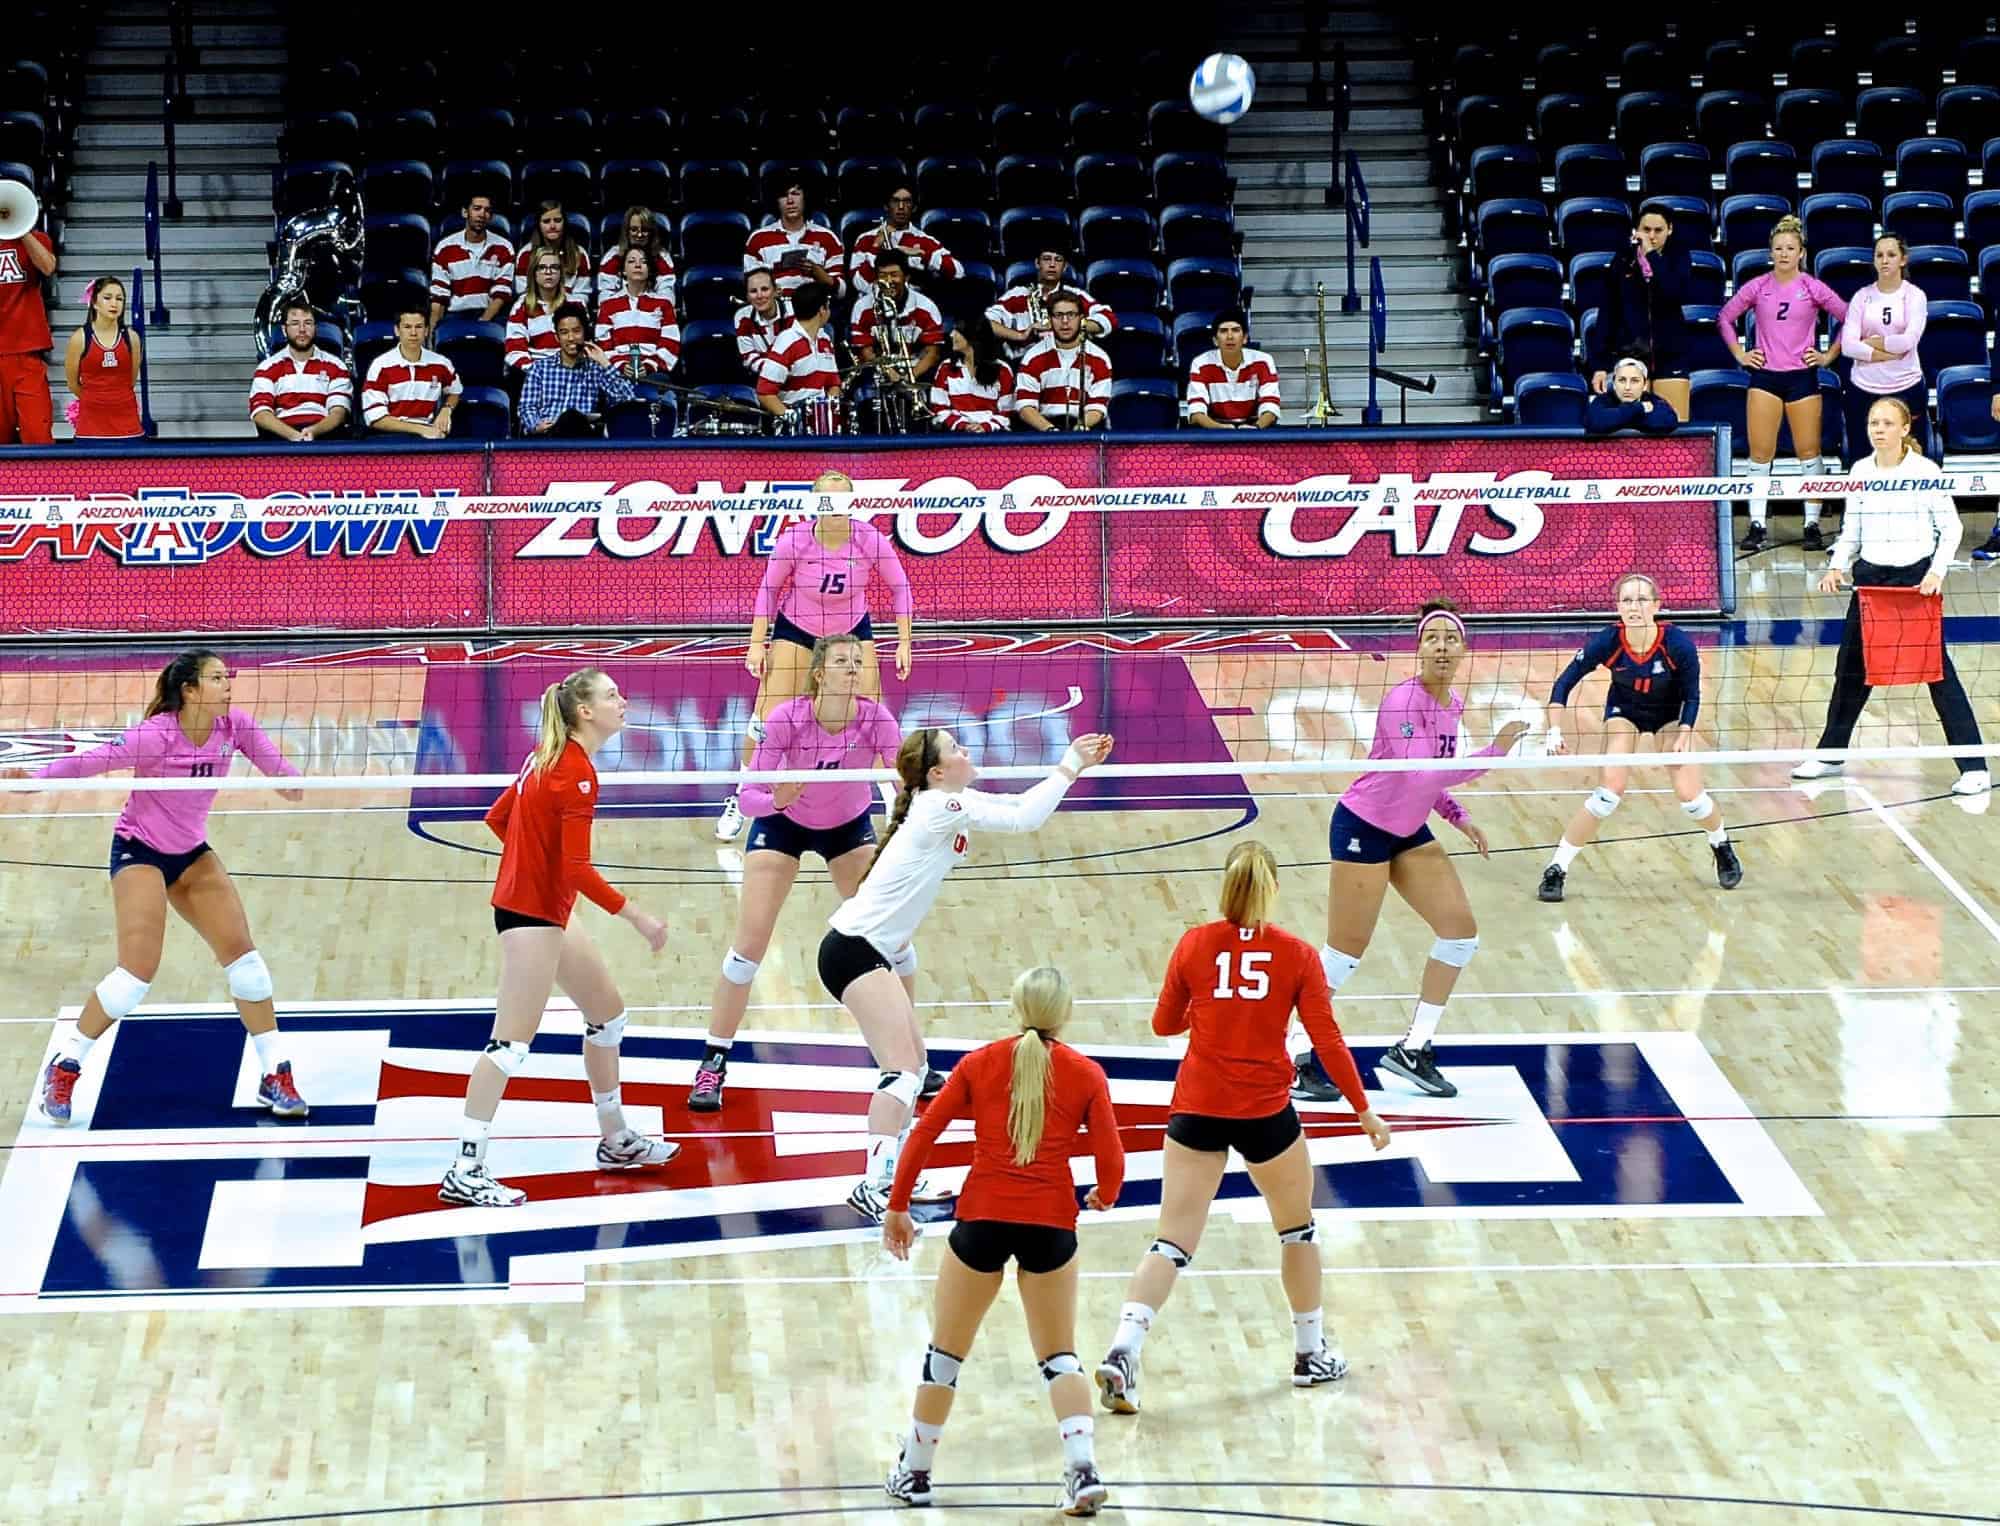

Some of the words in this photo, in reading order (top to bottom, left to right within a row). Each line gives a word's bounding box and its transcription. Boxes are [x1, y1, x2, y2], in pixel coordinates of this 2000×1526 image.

[0, 249, 26, 282] A
[1776, 302, 1790, 321] 2
[1882, 307, 1892, 325] 5
[193, 491, 460, 557] DOWN
[1263, 471, 1554, 557] CATS
[819, 573, 846, 595] 15
[1213, 951, 1273, 999] 15
